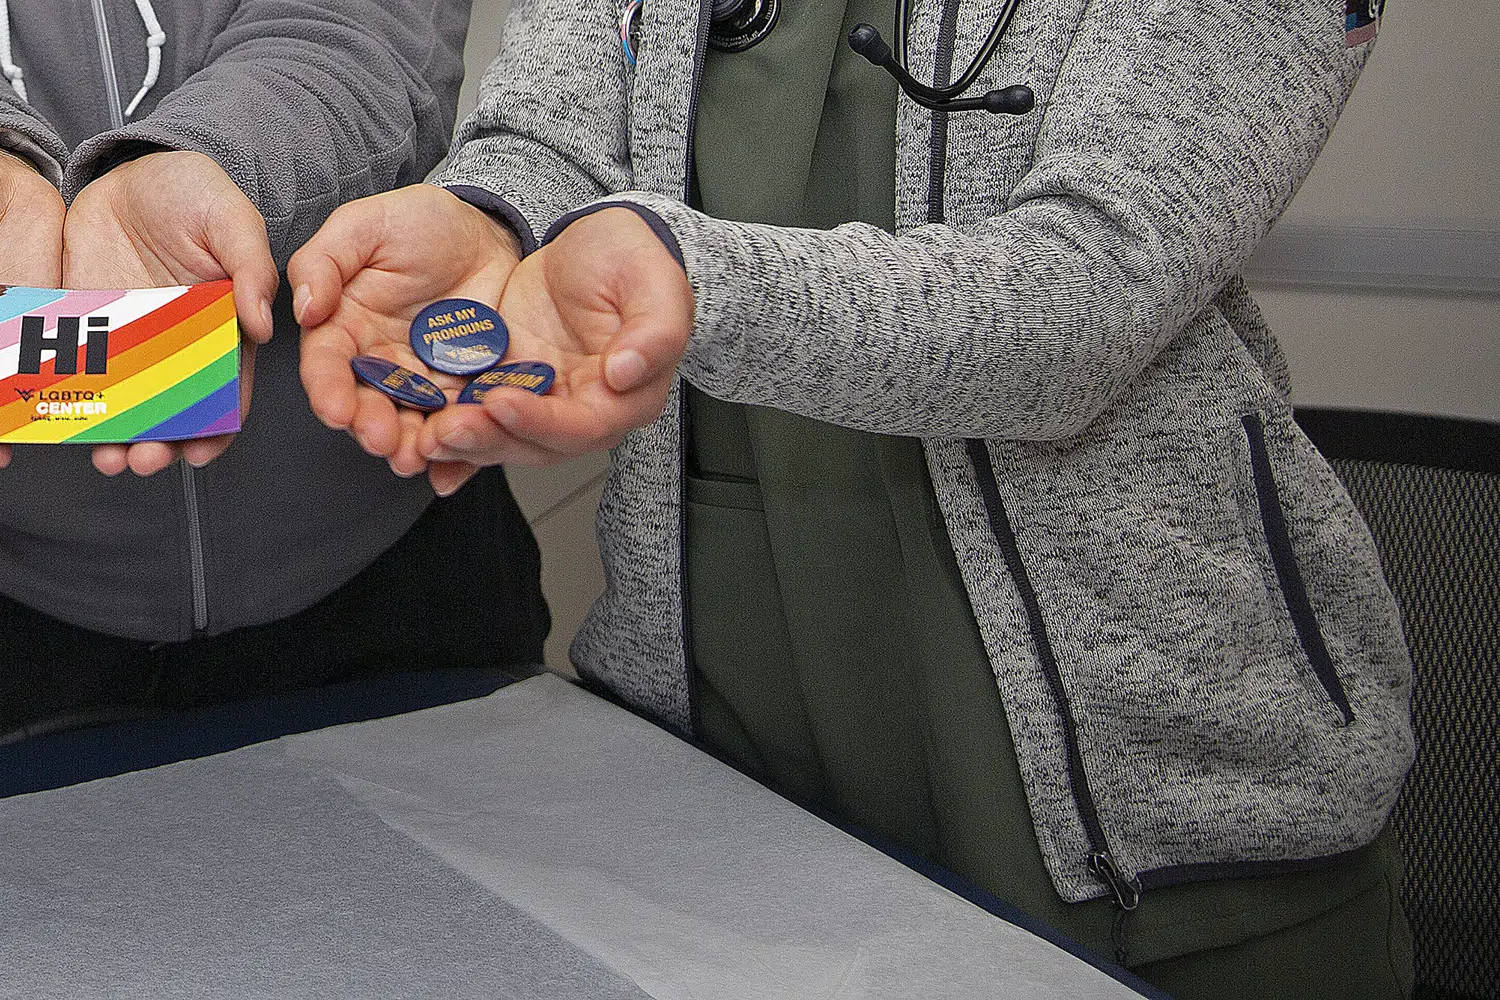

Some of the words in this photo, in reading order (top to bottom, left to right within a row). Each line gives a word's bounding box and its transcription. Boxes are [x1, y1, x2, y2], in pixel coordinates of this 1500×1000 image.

[427, 313, 455, 329] ASK
[454, 307, 477, 322] MY
[422, 319, 495, 345] PRONOUNS
[17, 315, 109, 375] Hi
[39, 390, 104, 401] LGBTQ+
[35, 401, 107, 415] CENTER
